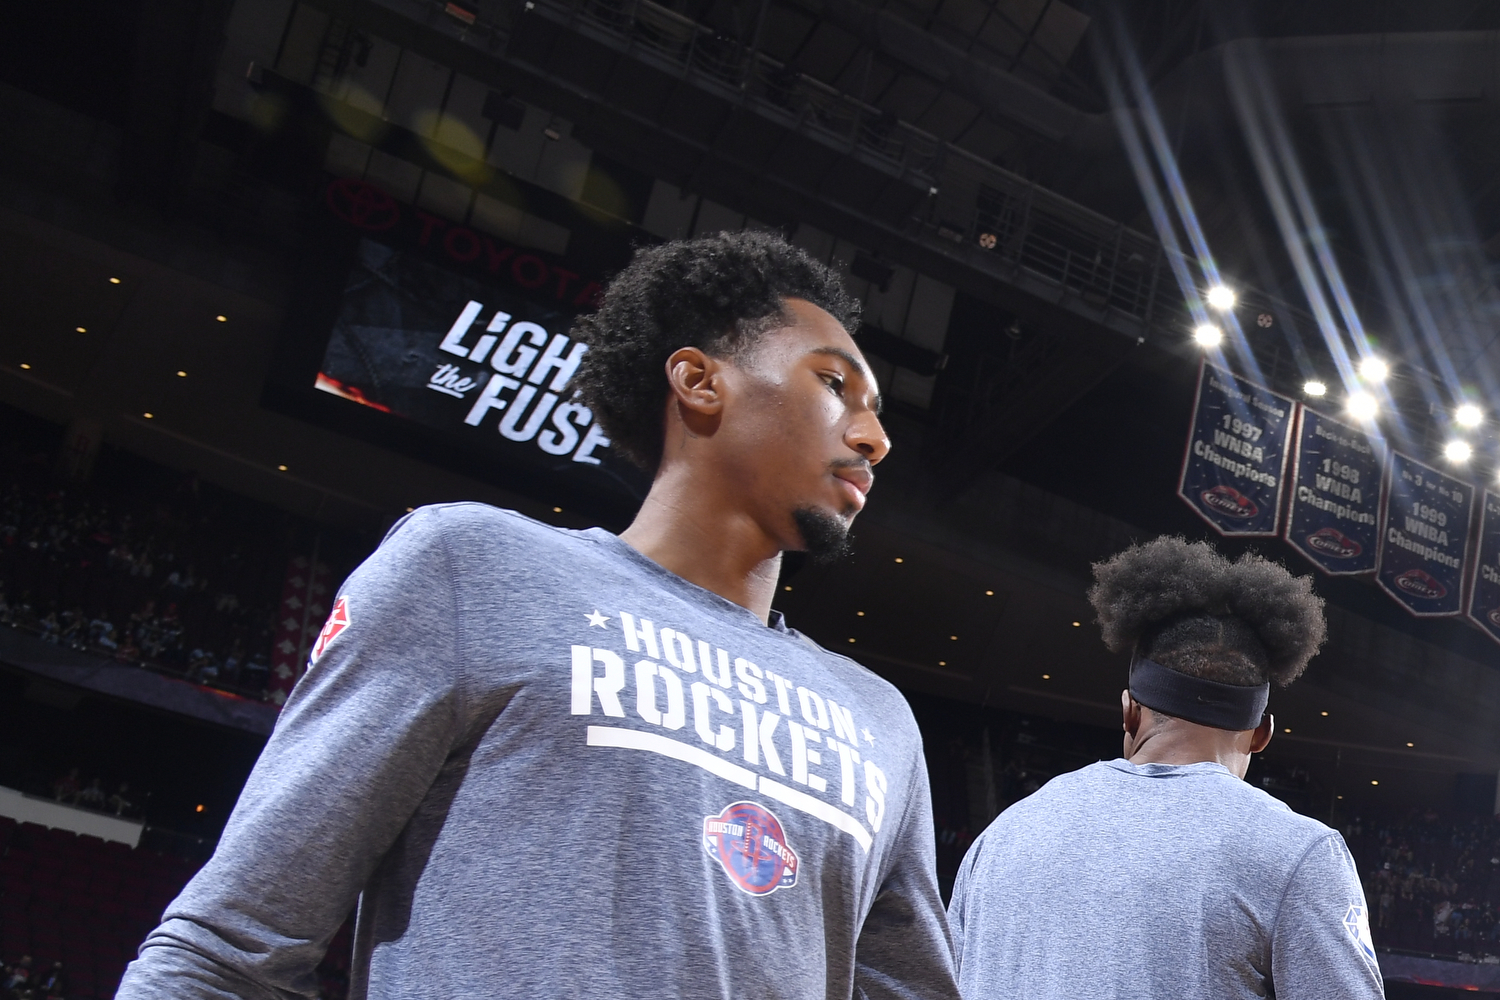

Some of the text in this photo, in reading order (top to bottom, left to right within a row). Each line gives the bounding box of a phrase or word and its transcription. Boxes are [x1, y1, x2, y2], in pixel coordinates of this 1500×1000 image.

[439, 300, 590, 394] LIGH
[428, 363, 477, 398] the
[464, 373, 611, 465] FUSE
[1223, 414, 1263, 442] 1997
[1214, 429, 1264, 463] WNBA
[1194, 440, 1276, 488] Champions
[1322, 458, 1361, 484] 1998
[1315, 473, 1362, 504] WNBA
[1298, 486, 1375, 526] Champions
[1412, 502, 1447, 527] 1999
[1388, 527, 1460, 569] Champions
[1405, 516, 1448, 546] WNBA
[619, 611, 859, 748] HOUSTON
[571, 644, 888, 833] ROCKETS
[708, 821, 744, 837] HOUSTON
[763, 835, 795, 868] ROCKETS
